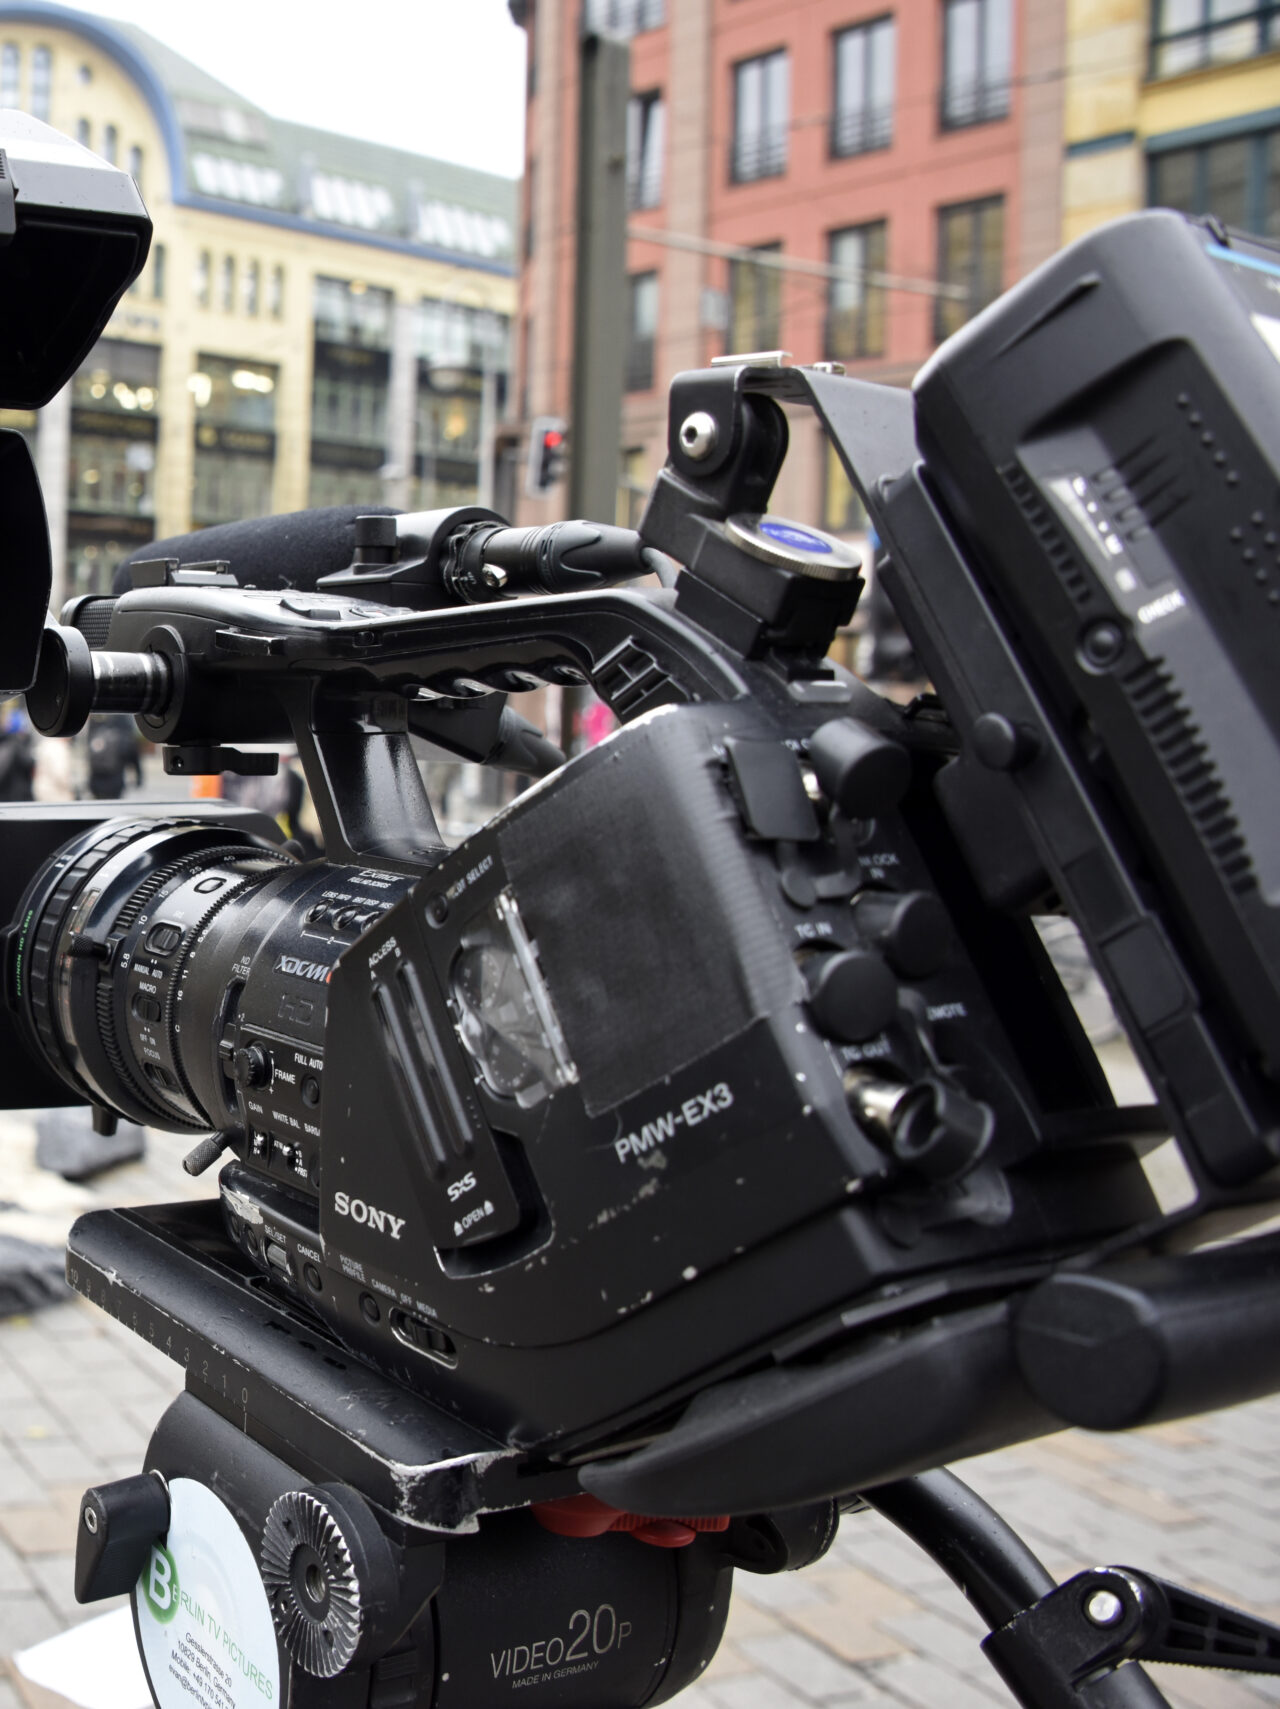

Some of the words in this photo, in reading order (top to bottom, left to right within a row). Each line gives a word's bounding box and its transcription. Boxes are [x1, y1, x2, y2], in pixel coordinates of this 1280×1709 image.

[466, 855, 494, 885] SELECT
[369, 936, 397, 968] ACCESS
[231, 963, 252, 976] FILTER
[138, 981, 157, 995] MACRO
[294, 1052, 308, 1067] FULL
[308, 1057, 324, 1072] AUTO
[274, 1068, 296, 1085] FRAME
[248, 1101, 263, 1114] GAIN
[271, 1110, 289, 1125] WHITE
[614, 1081, 735, 1165] PMW-EX3
[334, 1191, 406, 1241] SONY
[461, 1206, 486, 1229] OPEN
[264, 1224, 287, 1243] SEL/SET
[297, 1243, 321, 1263] CANCEL
[371, 1278, 398, 1299] CAMERA
[184, 1347, 190, 1363] 3
[202, 1360, 209, 1377] 2
[490, 1637, 564, 1679] VIDEO
[565, 1603, 616, 1662] 20
[207, 1613, 221, 1641] TV
[222, 1630, 273, 1700] PICTURES
[224, 1673, 233, 1688] 20
[512, 1674, 539, 1688] MADE
[541, 1671, 552, 1682] IN
[553, 1660, 599, 1678] GERMANY
[213, 1676, 236, 1709] Germany
